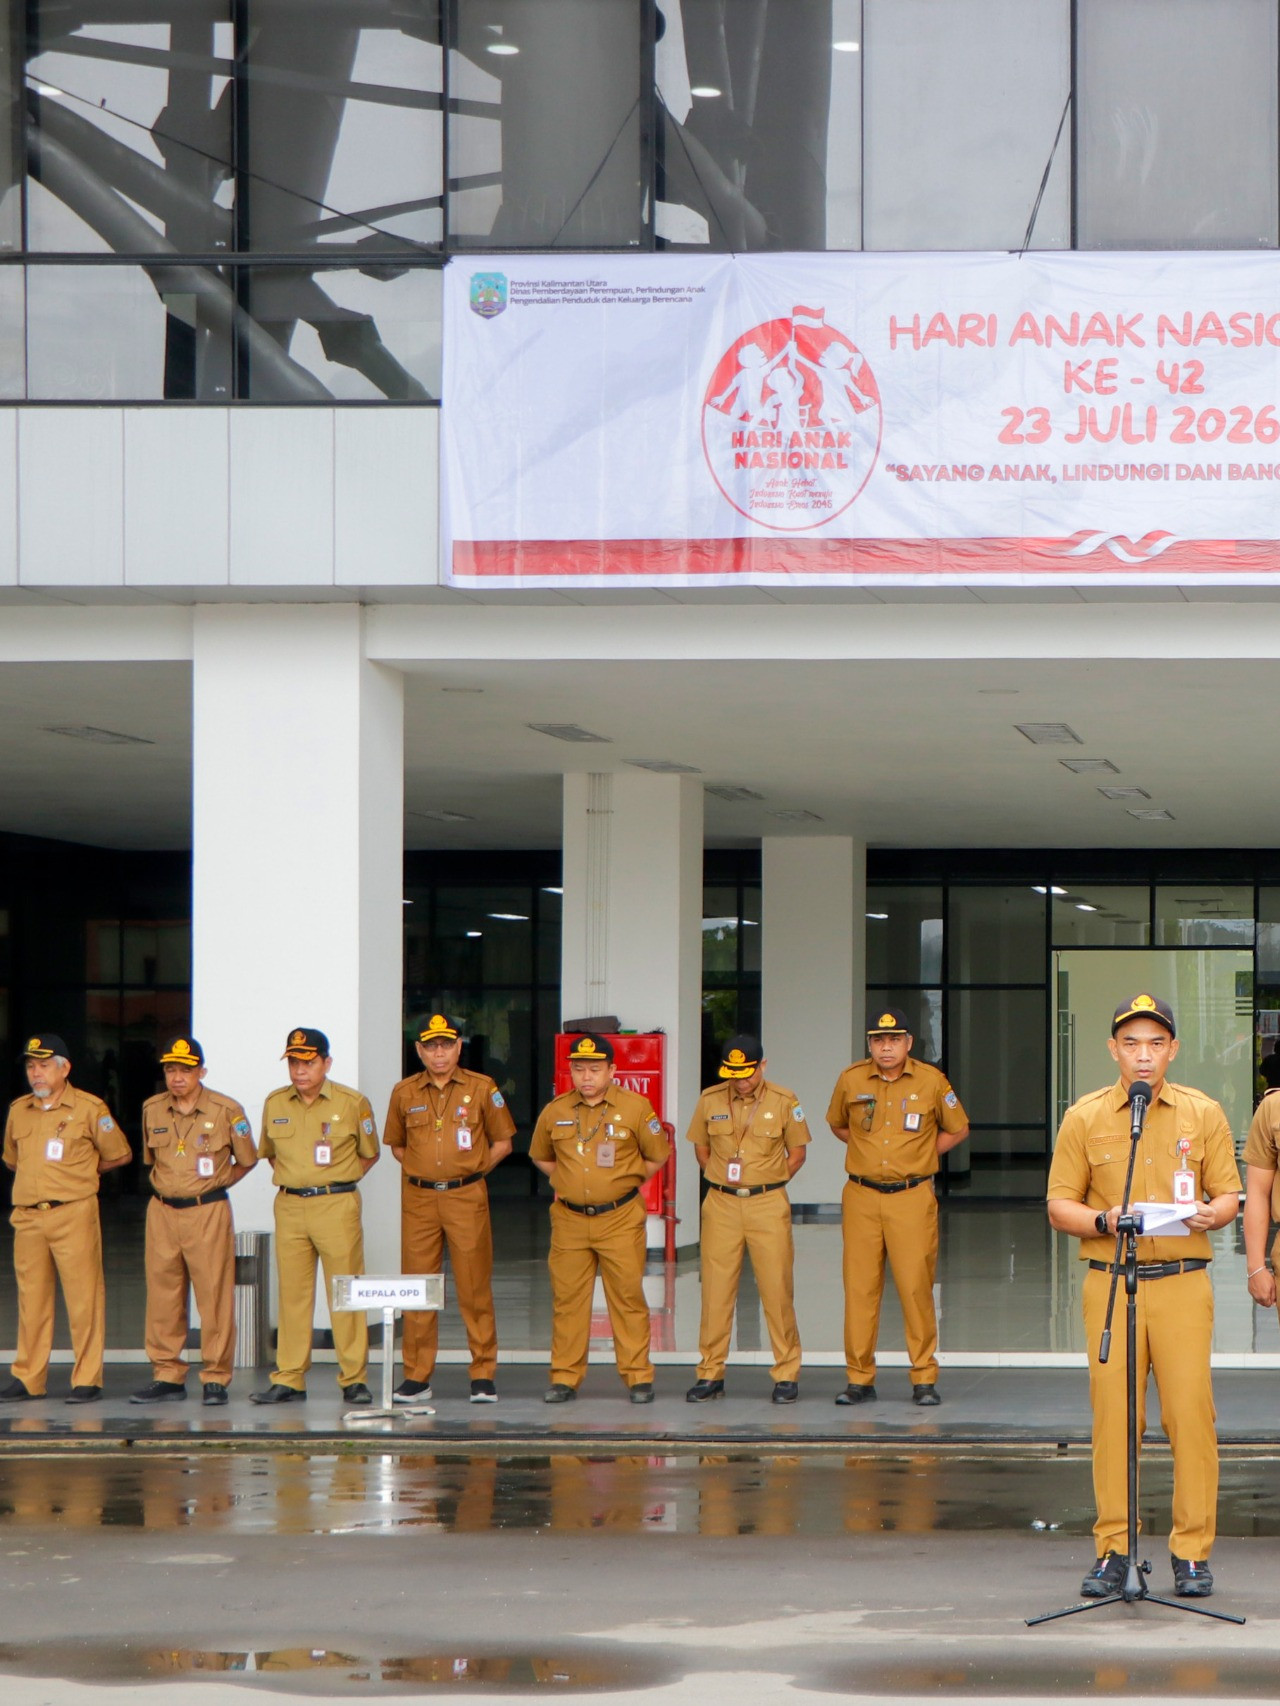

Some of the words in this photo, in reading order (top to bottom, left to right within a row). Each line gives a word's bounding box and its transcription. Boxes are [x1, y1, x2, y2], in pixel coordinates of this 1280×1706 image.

[510, 280, 540, 288] Provinsi
[541, 280, 585, 288] Kalimantan
[510, 287, 531, 295] Dinas
[532, 287, 588, 296] Pemberdayaan
[636, 286, 685, 296] Perlindungan
[510, 297, 561, 306] Pengendalian
[617, 296, 651, 305] Keluarga
[652, 295, 693, 303] Berencana
[889, 312, 997, 350] HARI
[1009, 311, 1146, 347] ANAK
[1064, 357, 1118, 395] KE
[1156, 359, 1205, 395] 42
[998, 406, 1052, 445] 23
[1064, 402, 1157, 445] JULI
[1170, 405, 1280, 444] 2026
[732, 431, 782, 448] HARI
[789, 431, 852, 448] ANAK
[734, 451, 849, 469] NASIONAL
[988, 464, 1057, 484] ANAK,
[1062, 463, 1170, 482] LINDUNGI
[1175, 463, 1222, 481] DAN
[357, 1289, 397, 1298] KEPALA
[399, 1289, 420, 1297] OPD
